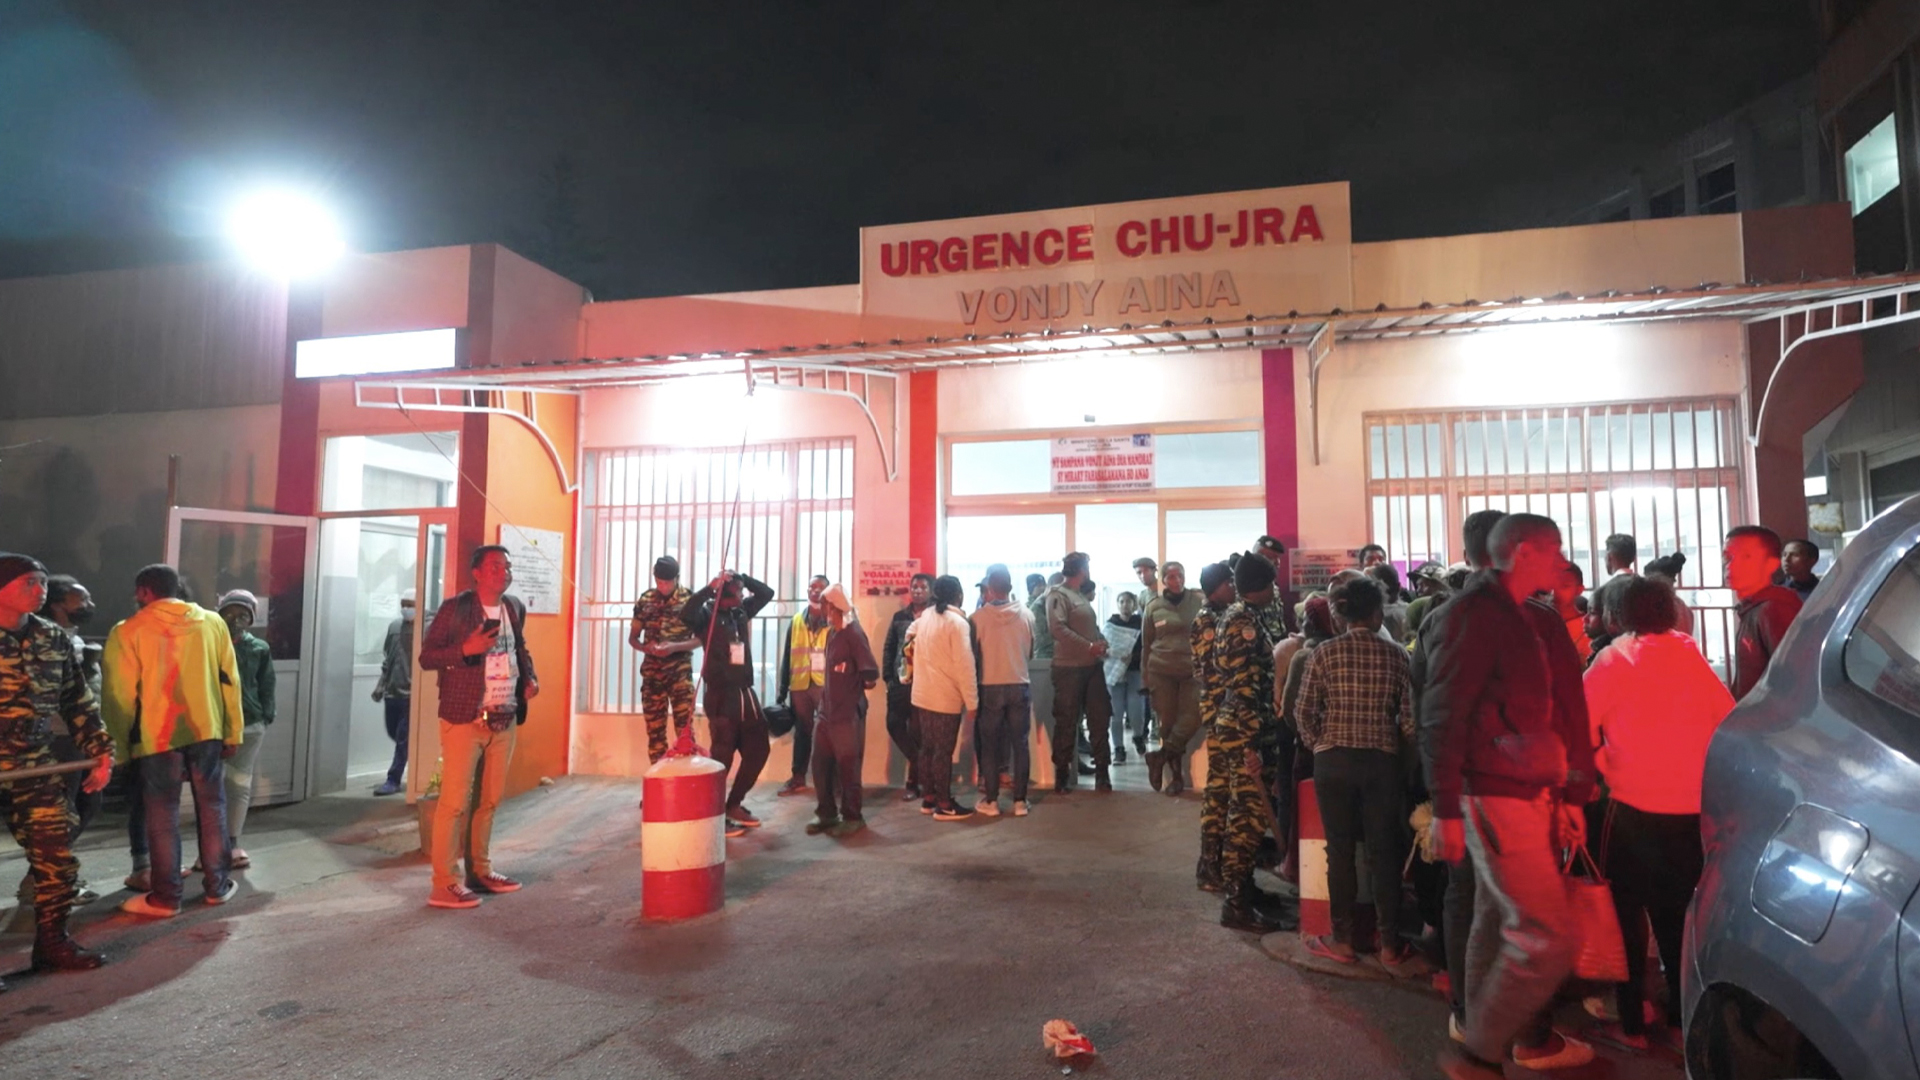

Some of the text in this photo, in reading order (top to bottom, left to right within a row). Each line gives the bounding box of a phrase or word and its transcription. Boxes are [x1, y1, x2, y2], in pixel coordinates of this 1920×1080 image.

[880, 204, 1324, 277] URGENCE CHU-JRA
[955, 269, 1241, 325] VONJY AINA
